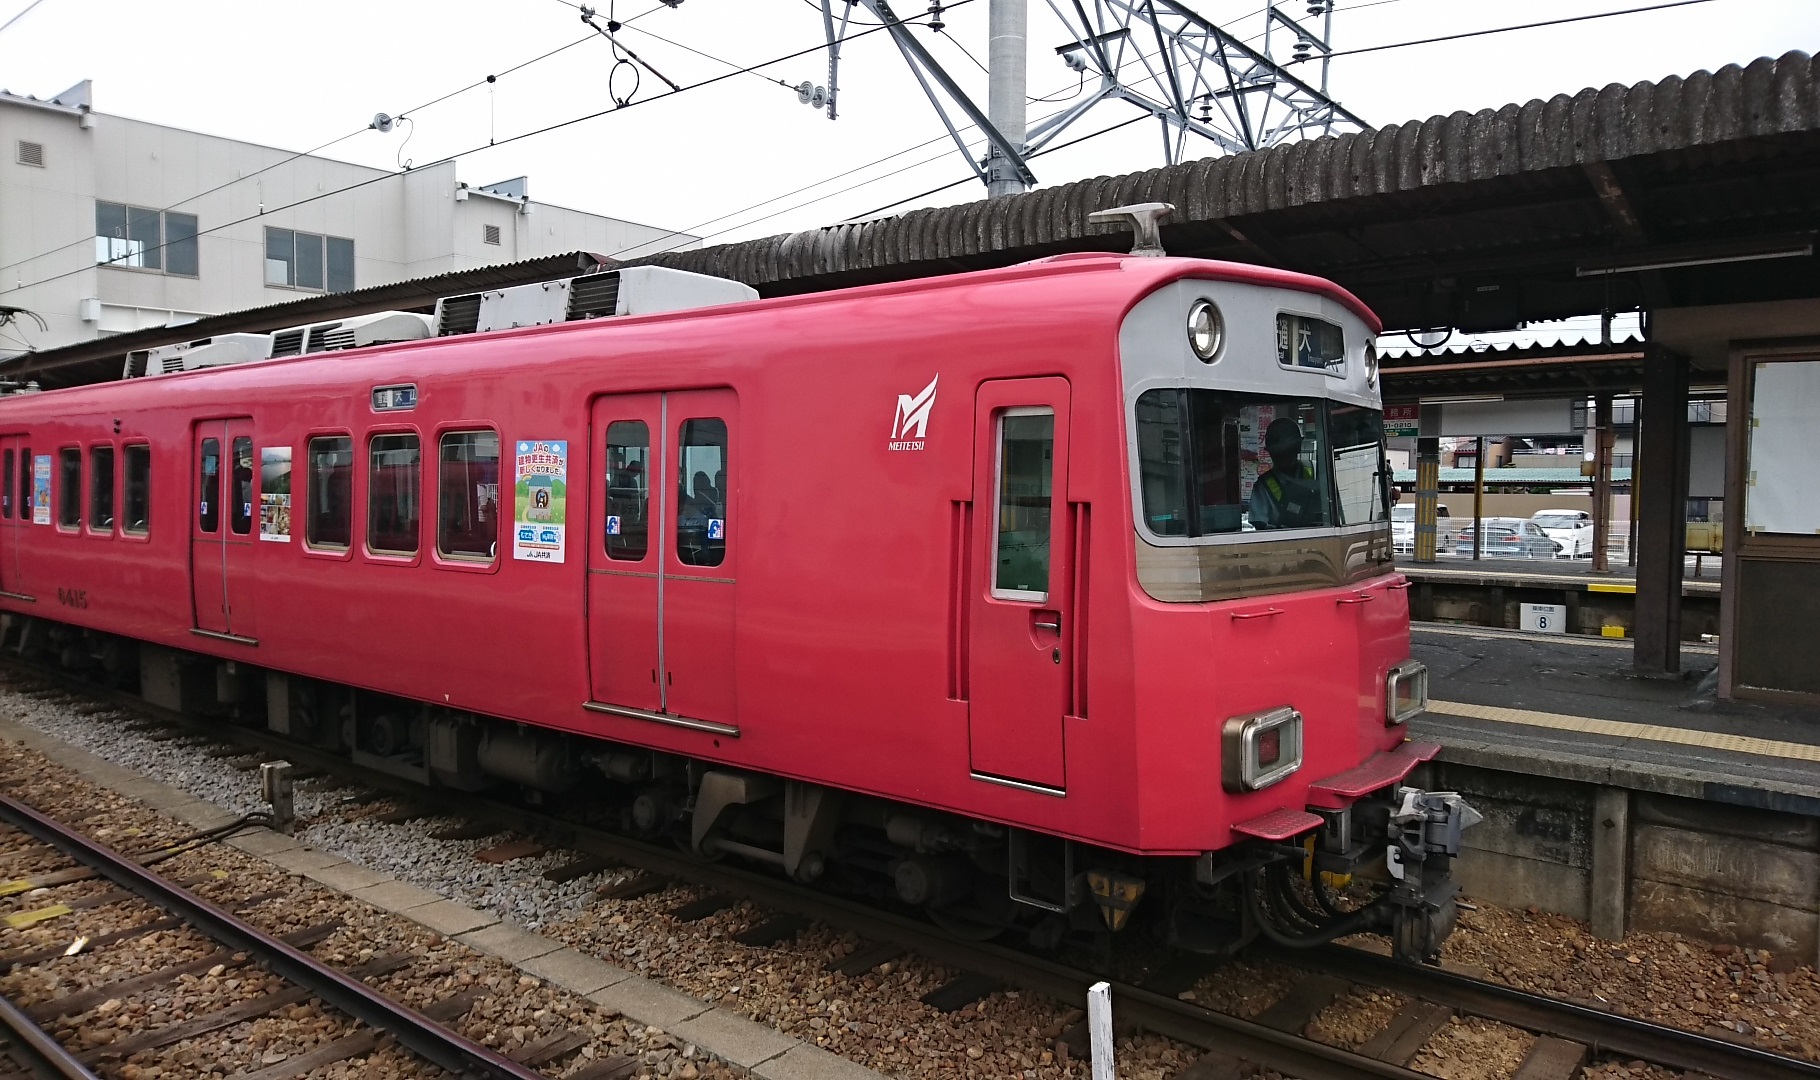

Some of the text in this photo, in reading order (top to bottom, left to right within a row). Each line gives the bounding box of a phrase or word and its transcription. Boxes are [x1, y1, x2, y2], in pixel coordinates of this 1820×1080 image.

[533, 443, 549, 452] JAの
[888, 441, 925, 451] MEITETSU
[1539, 616, 1547, 629] 8
